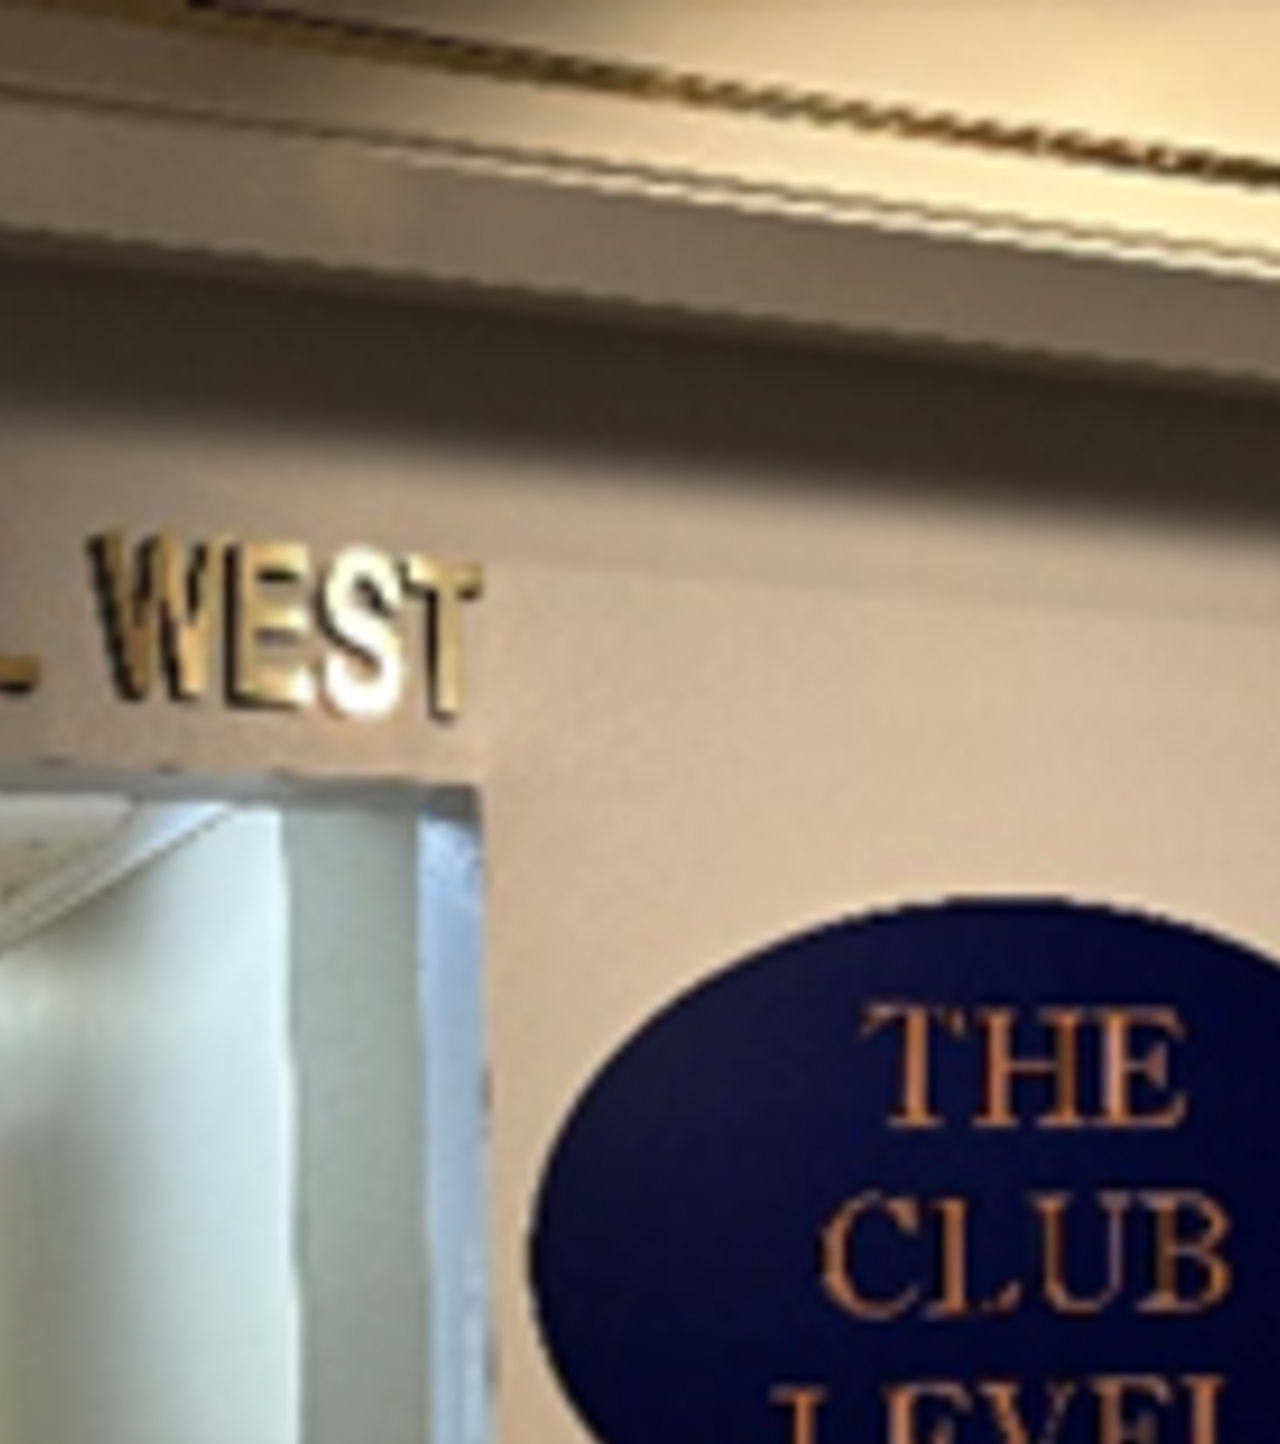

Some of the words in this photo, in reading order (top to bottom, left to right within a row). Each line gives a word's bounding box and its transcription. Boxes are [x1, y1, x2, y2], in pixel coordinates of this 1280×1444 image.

[87, 530, 484, 724] WEST
[860, 1002, 1188, 1130] THE
[820, 1190, 1234, 1320] CLUB
